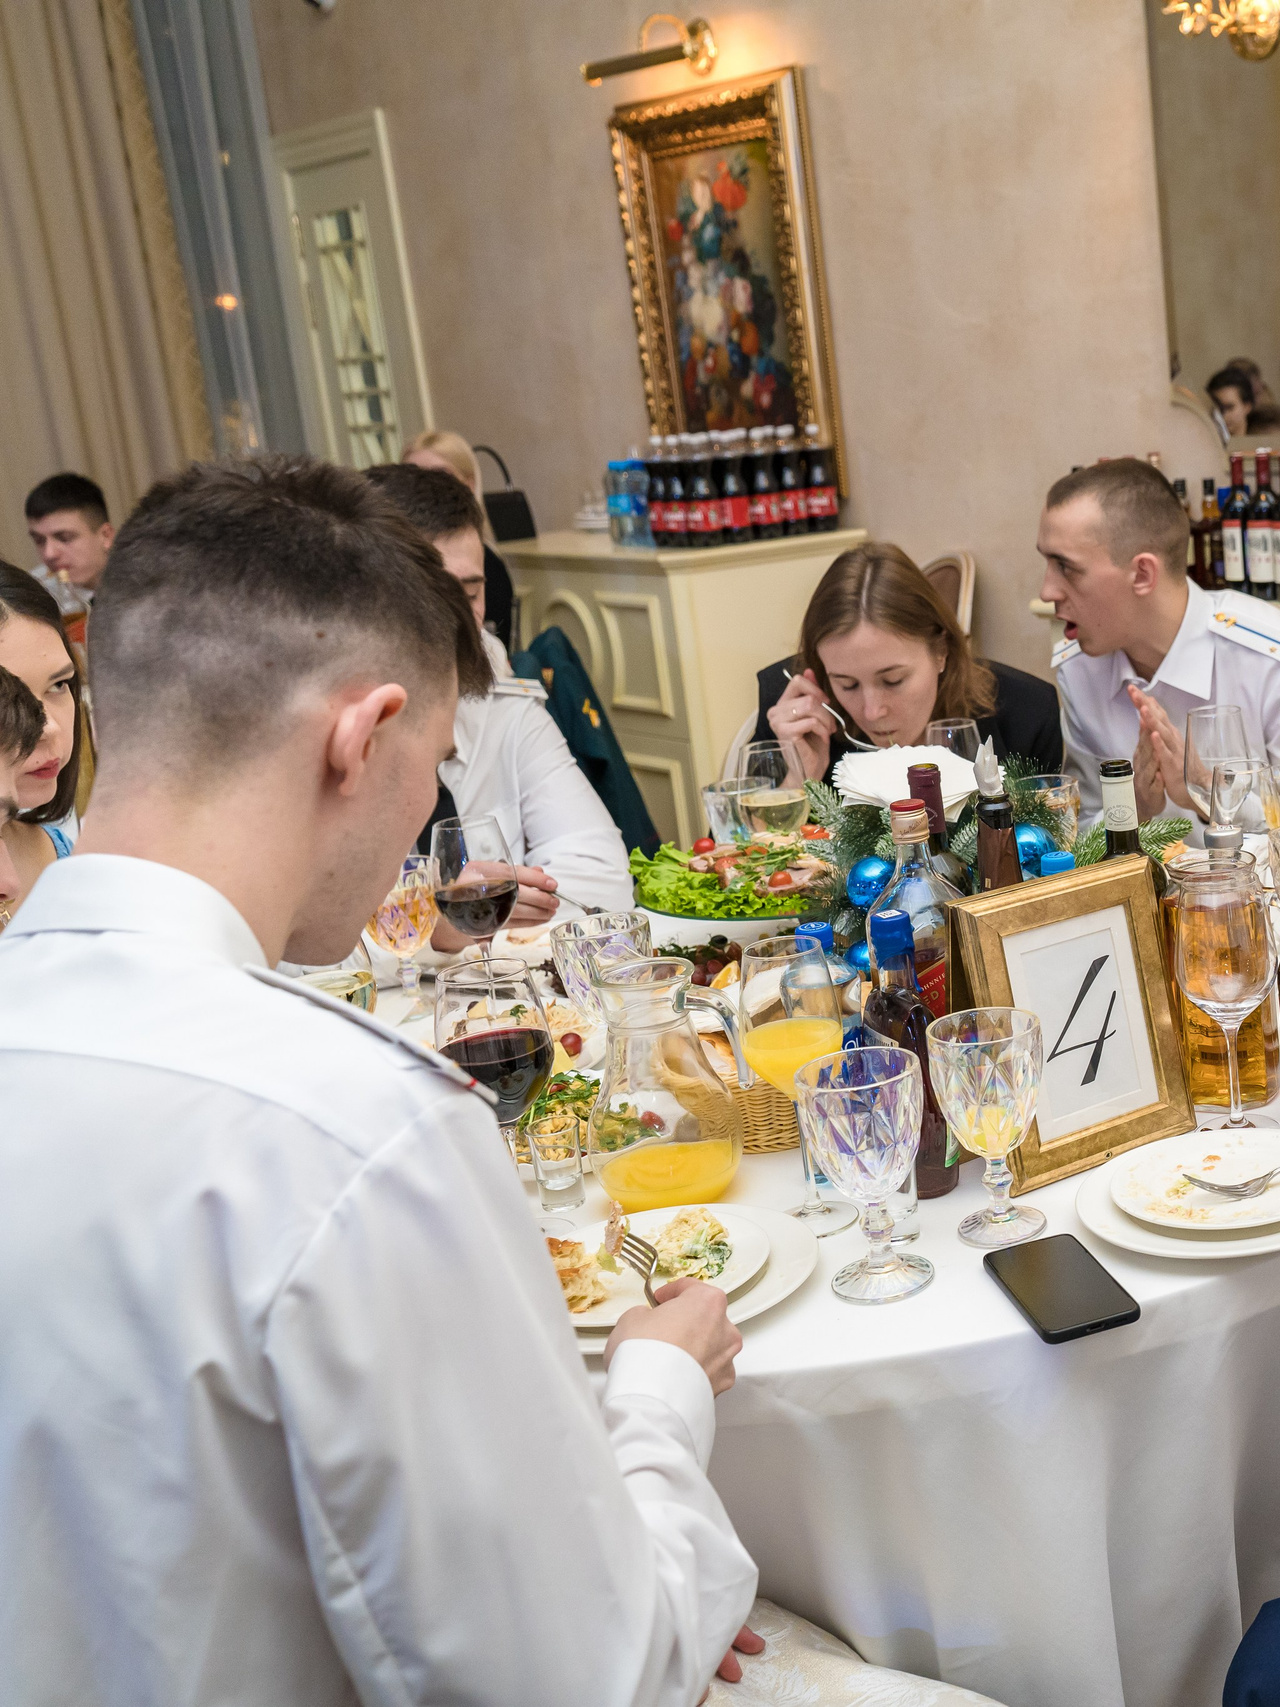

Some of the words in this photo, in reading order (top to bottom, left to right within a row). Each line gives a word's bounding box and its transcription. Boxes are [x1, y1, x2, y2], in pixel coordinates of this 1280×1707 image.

[920, 972, 945, 992] OHNNIE
[923, 990, 940, 1005] ED
[1047, 955, 1116, 1086] 4
